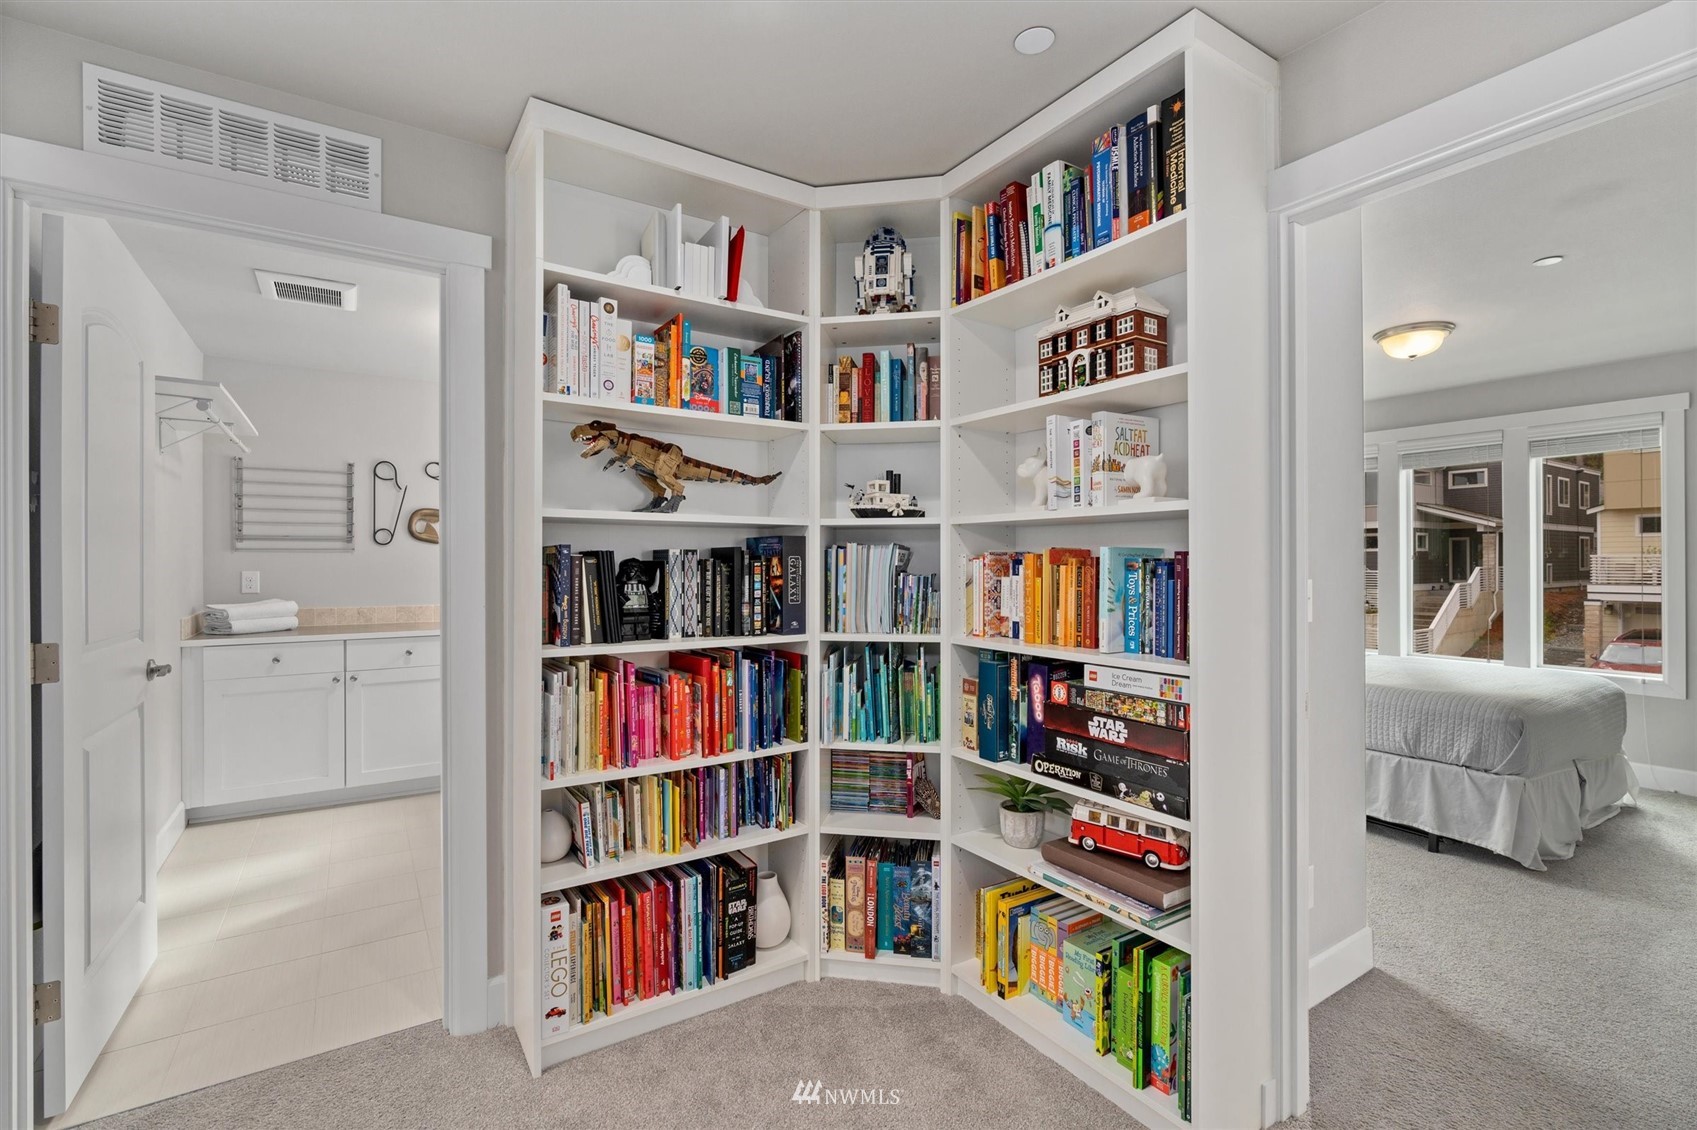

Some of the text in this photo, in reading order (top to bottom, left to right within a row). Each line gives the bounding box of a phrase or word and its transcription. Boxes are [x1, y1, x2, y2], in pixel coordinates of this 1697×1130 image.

[1170, 154, 1178, 205] Medicine
[693, 391, 712, 402] Disney
[1115, 426, 1148, 443] SALT FAT
[1113, 441, 1151, 457] ACID HEAT
[1127, 572, 1138, 636] Toys & Prices
[1111, 672, 1143, 684] Ice Cream
[1111, 679, 1132, 689] Dream
[1033, 676, 1043, 720] Taboo
[1088, 715, 1128, 734] STAR
[1088, 725, 1128, 744] WARS
[1056, 736, 1088, 756] Risk
[1034, 759, 1082, 780] OPERATION
[1093, 748, 1120, 764] GAME
[1125, 756, 1170, 778] THRONES
[728, 898, 747, 908] STAR
[550, 948, 568, 998] LEGO
[1039, 954, 1047, 989] BIGGIE!
[1048, 958, 1056, 994] BIGGIE!
[1160, 973, 1169, 1004] CURIOUS
